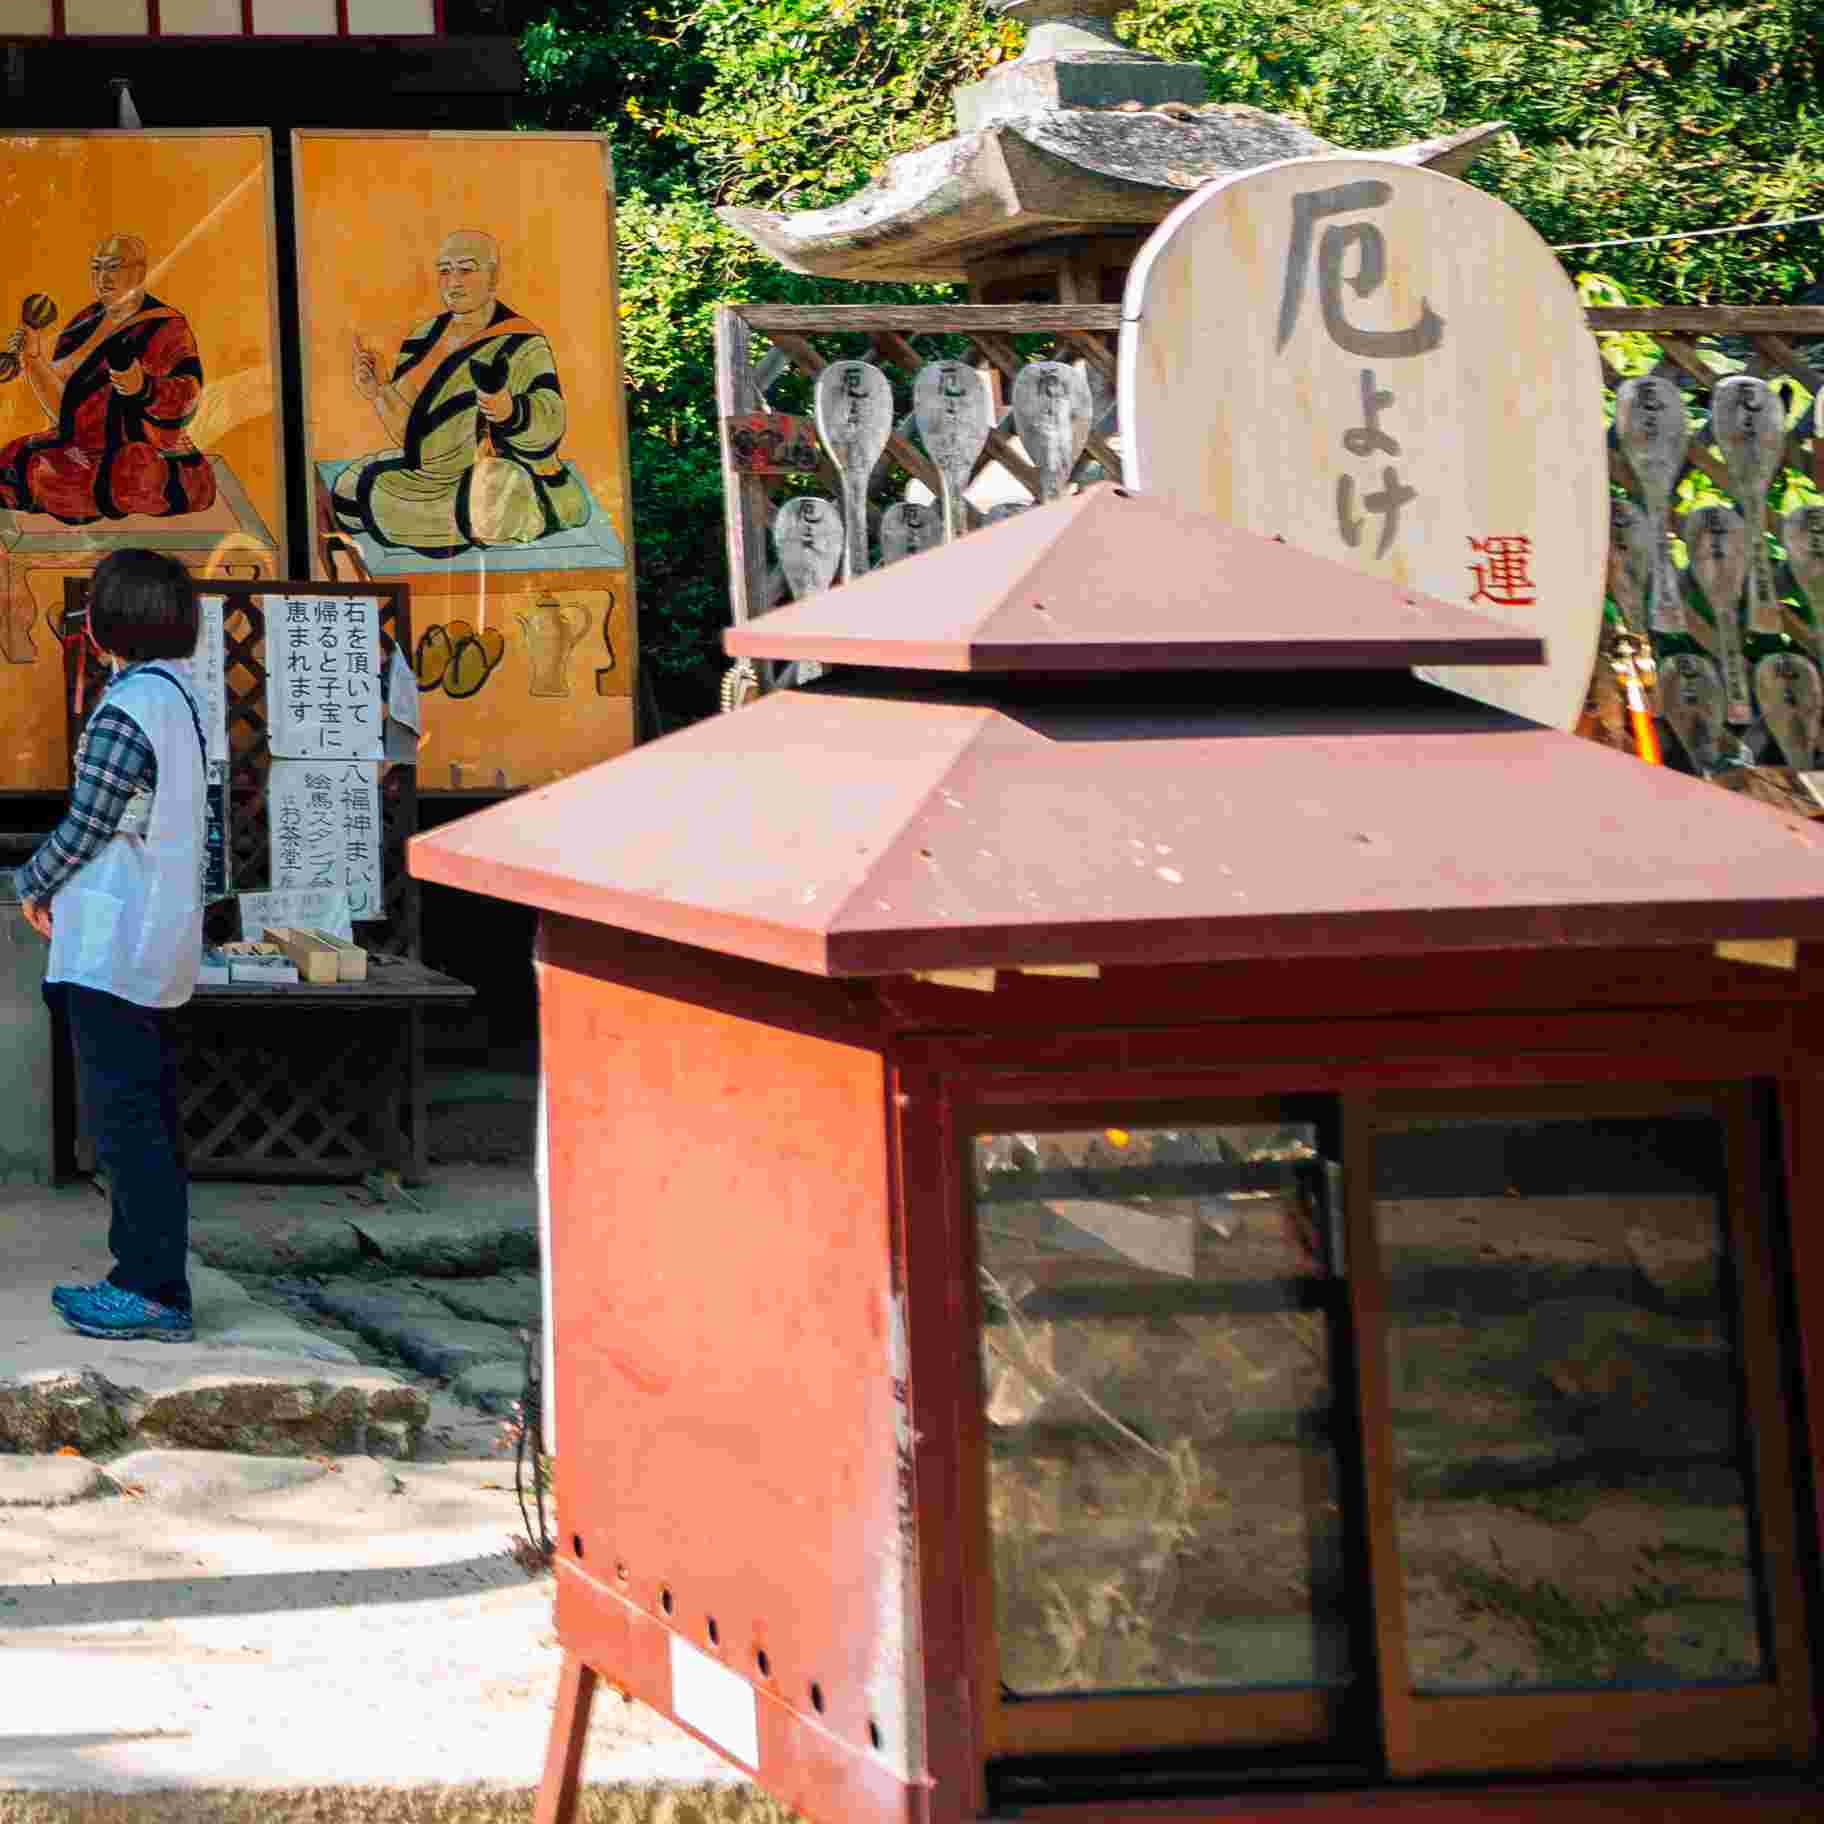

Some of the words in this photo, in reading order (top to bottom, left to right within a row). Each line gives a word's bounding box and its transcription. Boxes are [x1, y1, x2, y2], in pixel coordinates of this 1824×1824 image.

[1276, 177, 1446, 562] 厄よけ
[1465, 533, 1536, 607] 運
[286, 600, 314, 724] 恵まれます
[314, 600, 343, 749] 帰ると子宝に
[343, 600, 370, 724] 石を頂いて
